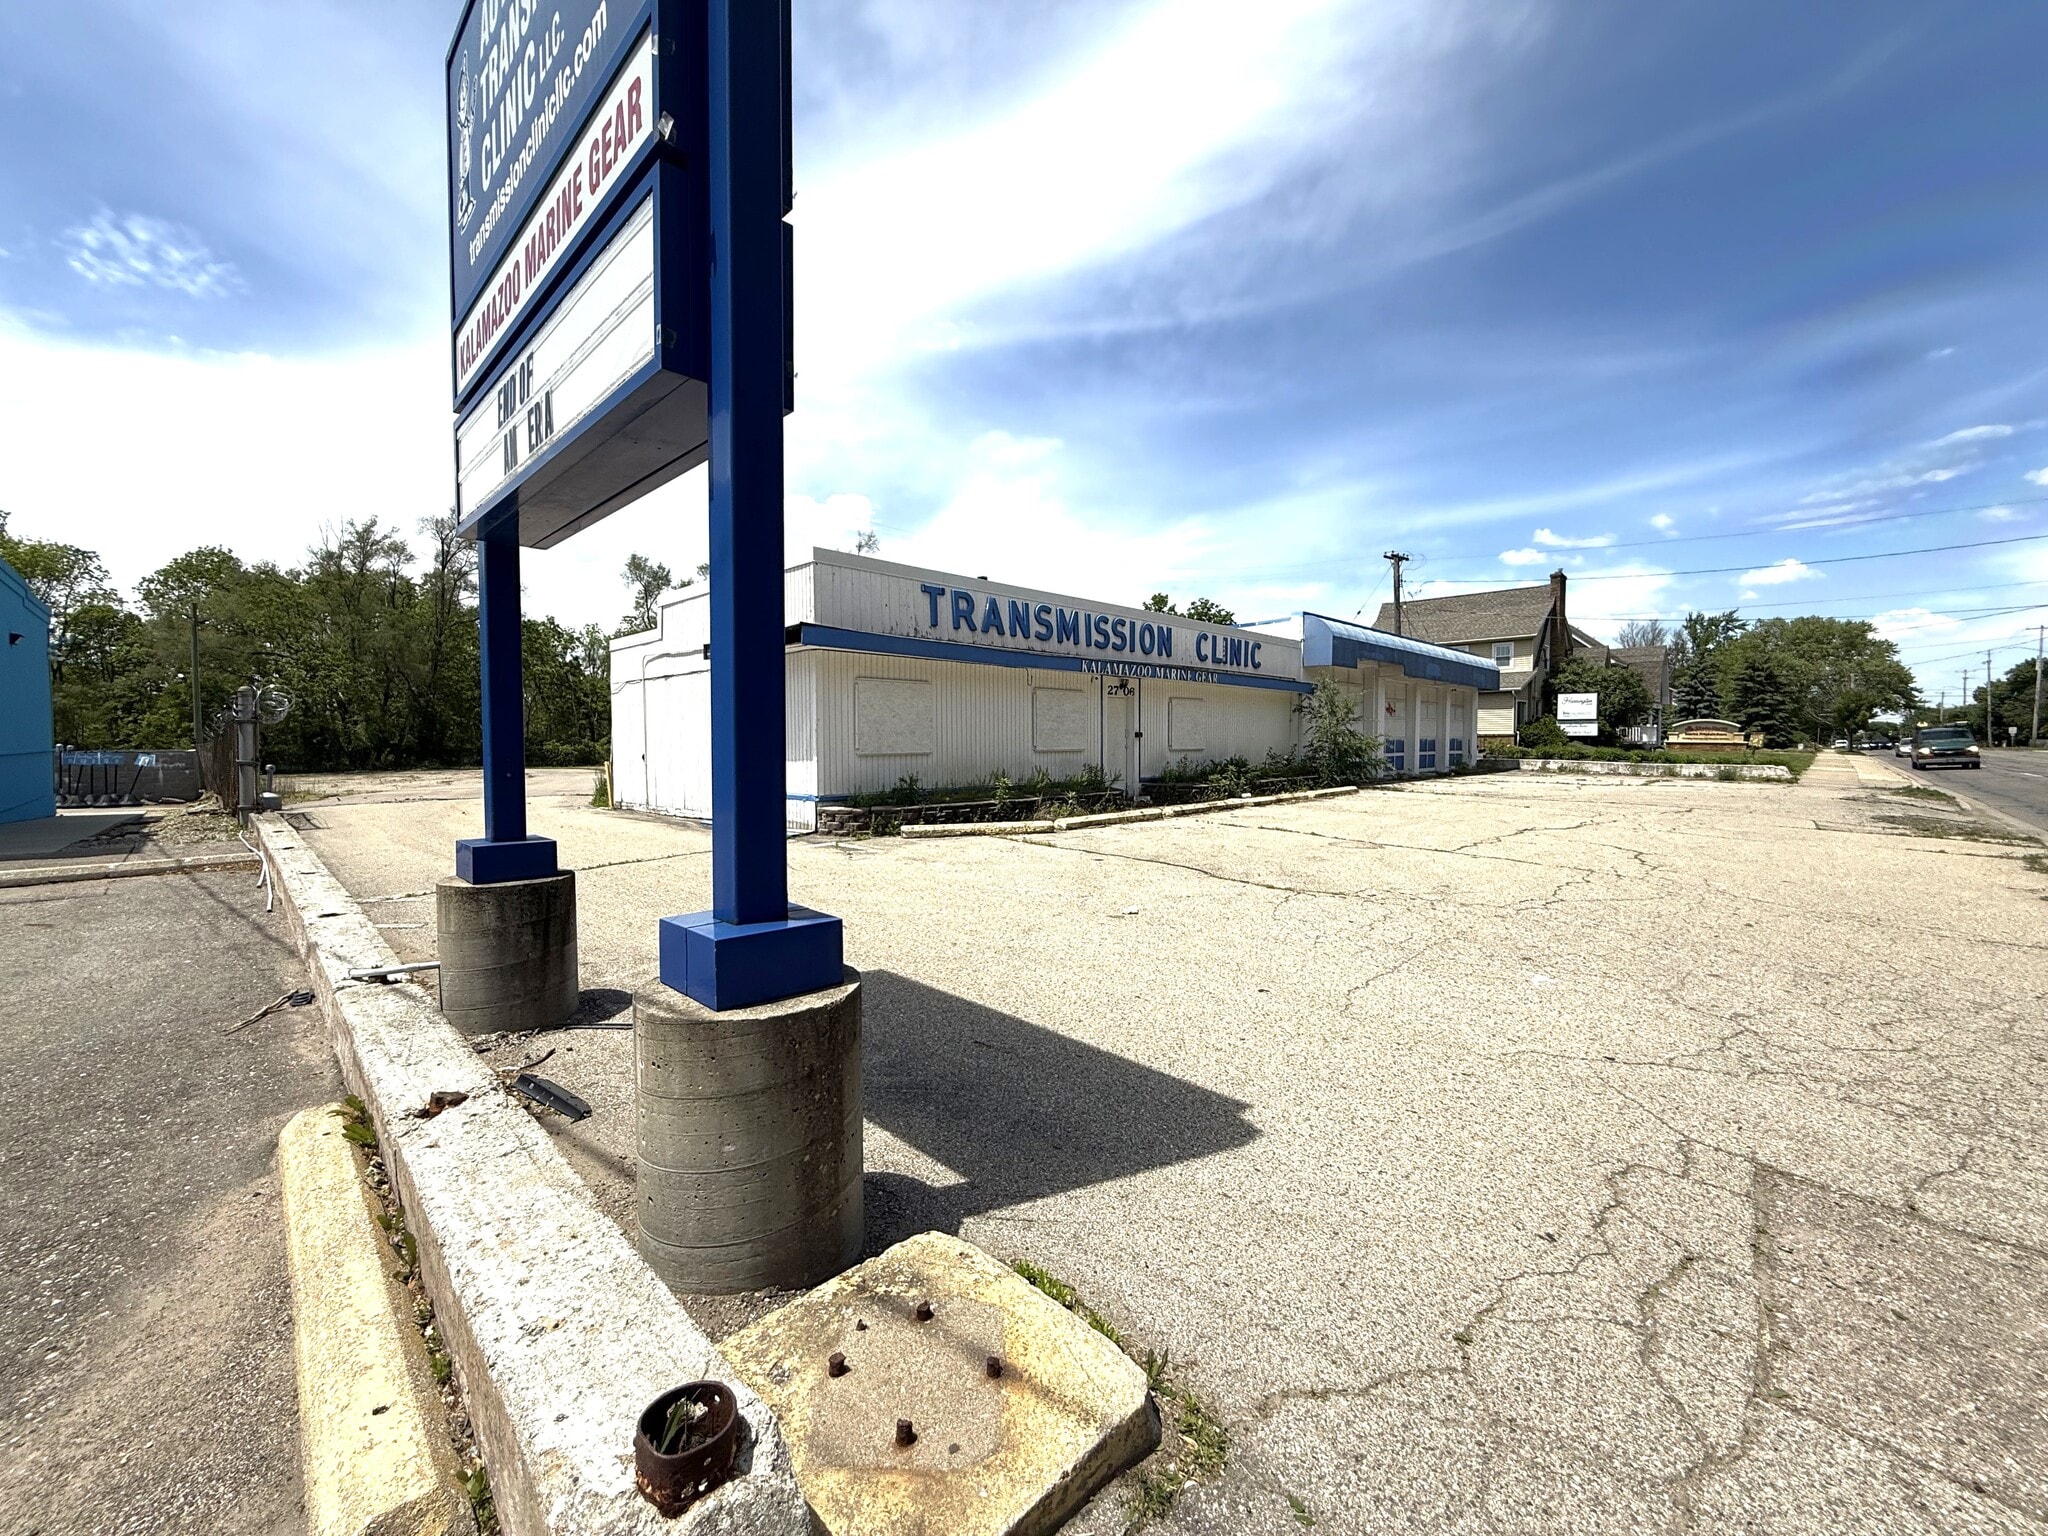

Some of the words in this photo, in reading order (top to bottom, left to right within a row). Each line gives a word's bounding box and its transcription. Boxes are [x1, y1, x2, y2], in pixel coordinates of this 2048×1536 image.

[480, 0, 539, 122] TRANS
[481, 40, 536, 192] CLINIC
[539, 11, 565, 84] LLC.
[469, 0, 607, 265] transmissionclinicllc.com
[460, 259, 521, 379] KALAMAZOO
[525, 161, 583, 290] MARINE
[588, 76, 643, 196] GEAR
[498, 372, 517, 430] END
[519, 351, 534, 406] OF
[504, 423, 518, 477] AN
[527, 388, 555, 455] ERA
[920, 583, 1173, 657] TRANSMISSION
[1195, 632, 1262, 669] CLINIC
[1081, 660, 1152, 678] KALAMAZOO
[1155, 667, 1192, 682] MARINE
